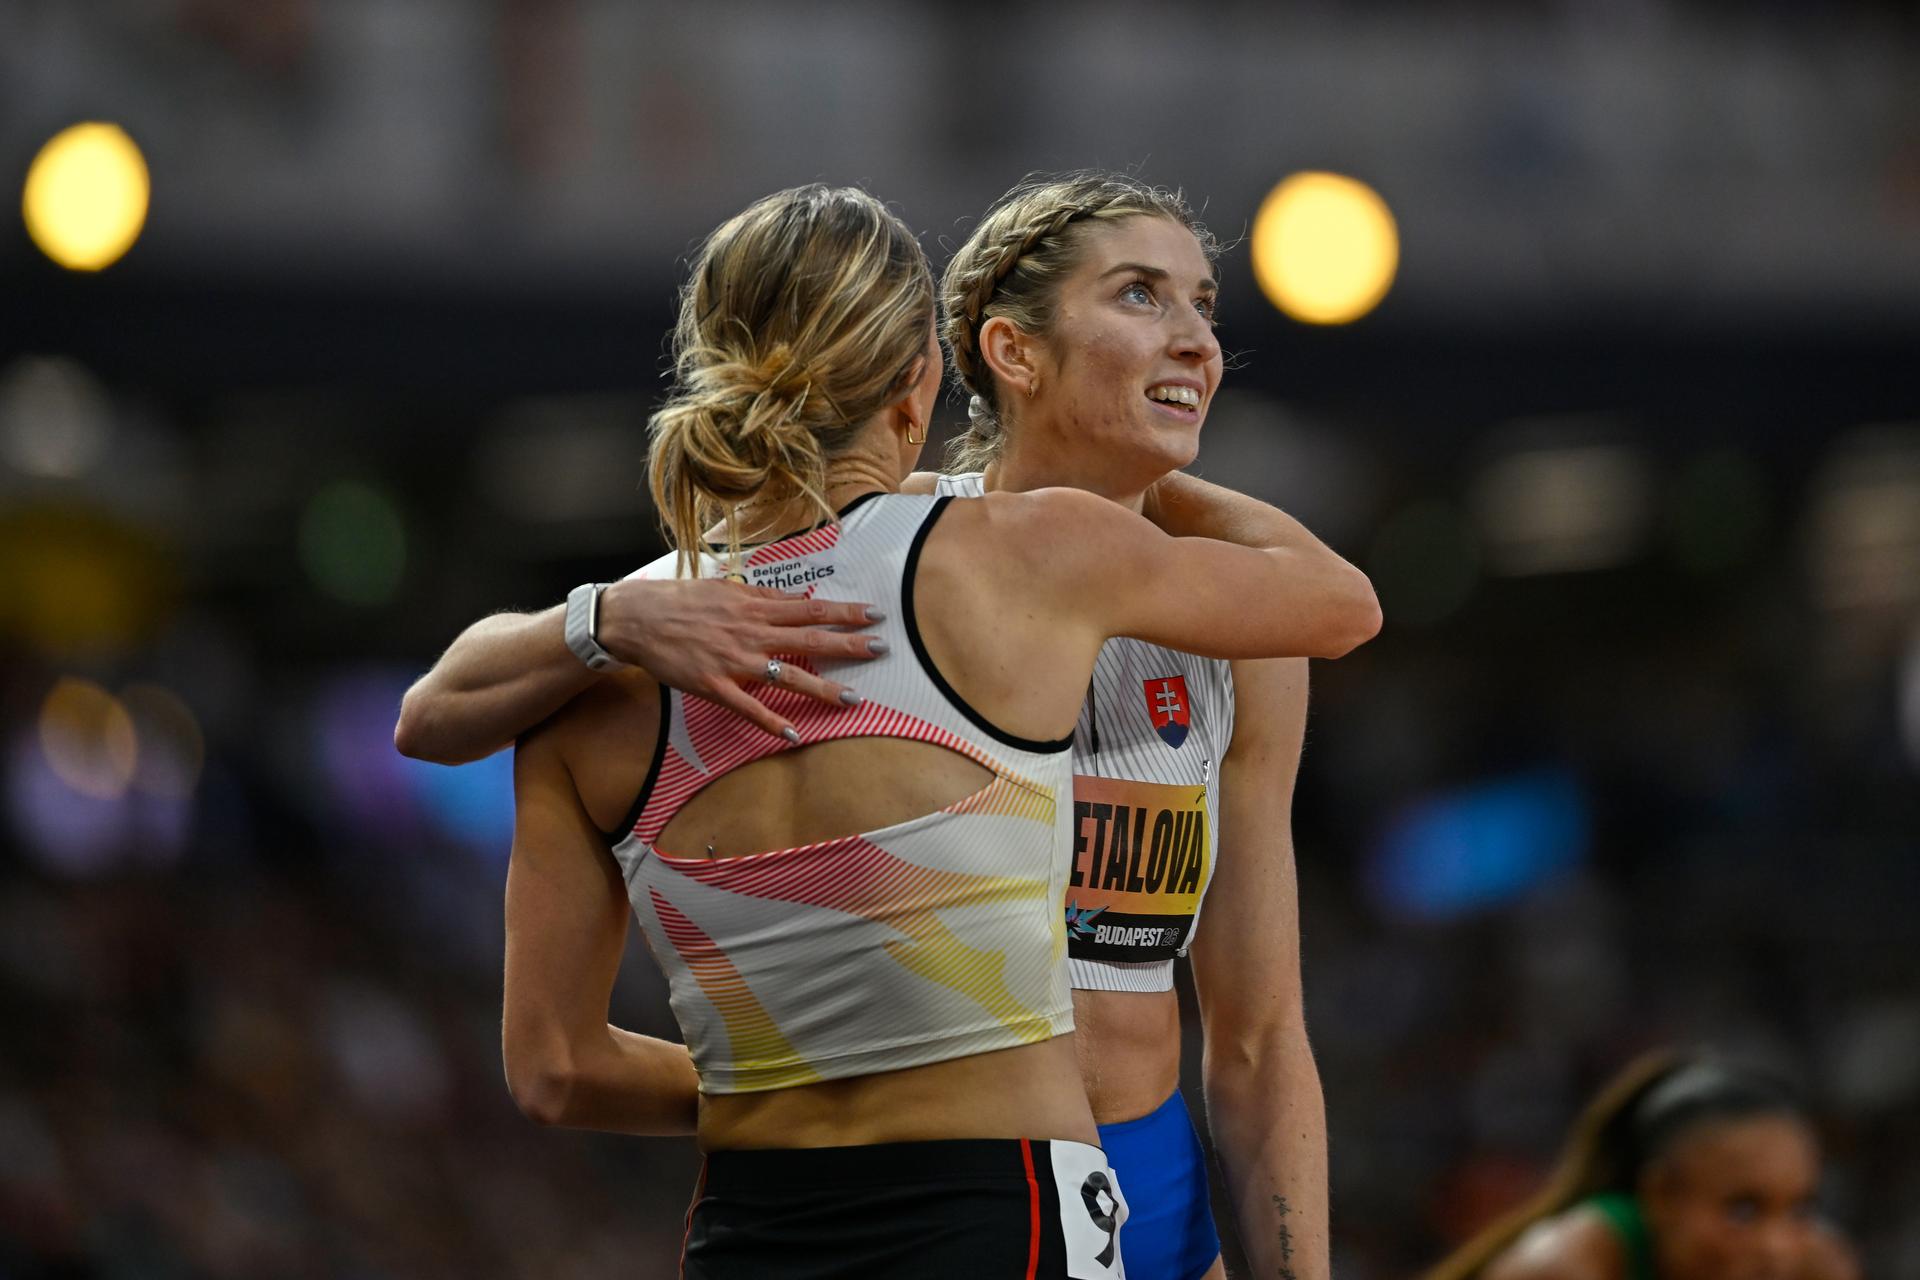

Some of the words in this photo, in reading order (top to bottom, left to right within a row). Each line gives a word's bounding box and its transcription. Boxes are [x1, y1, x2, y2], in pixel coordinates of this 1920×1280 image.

[753, 562, 800, 577] Belgian
[1095, 924, 1165, 947] BUDAPEST
[1080, 1171, 1119, 1269] 9
